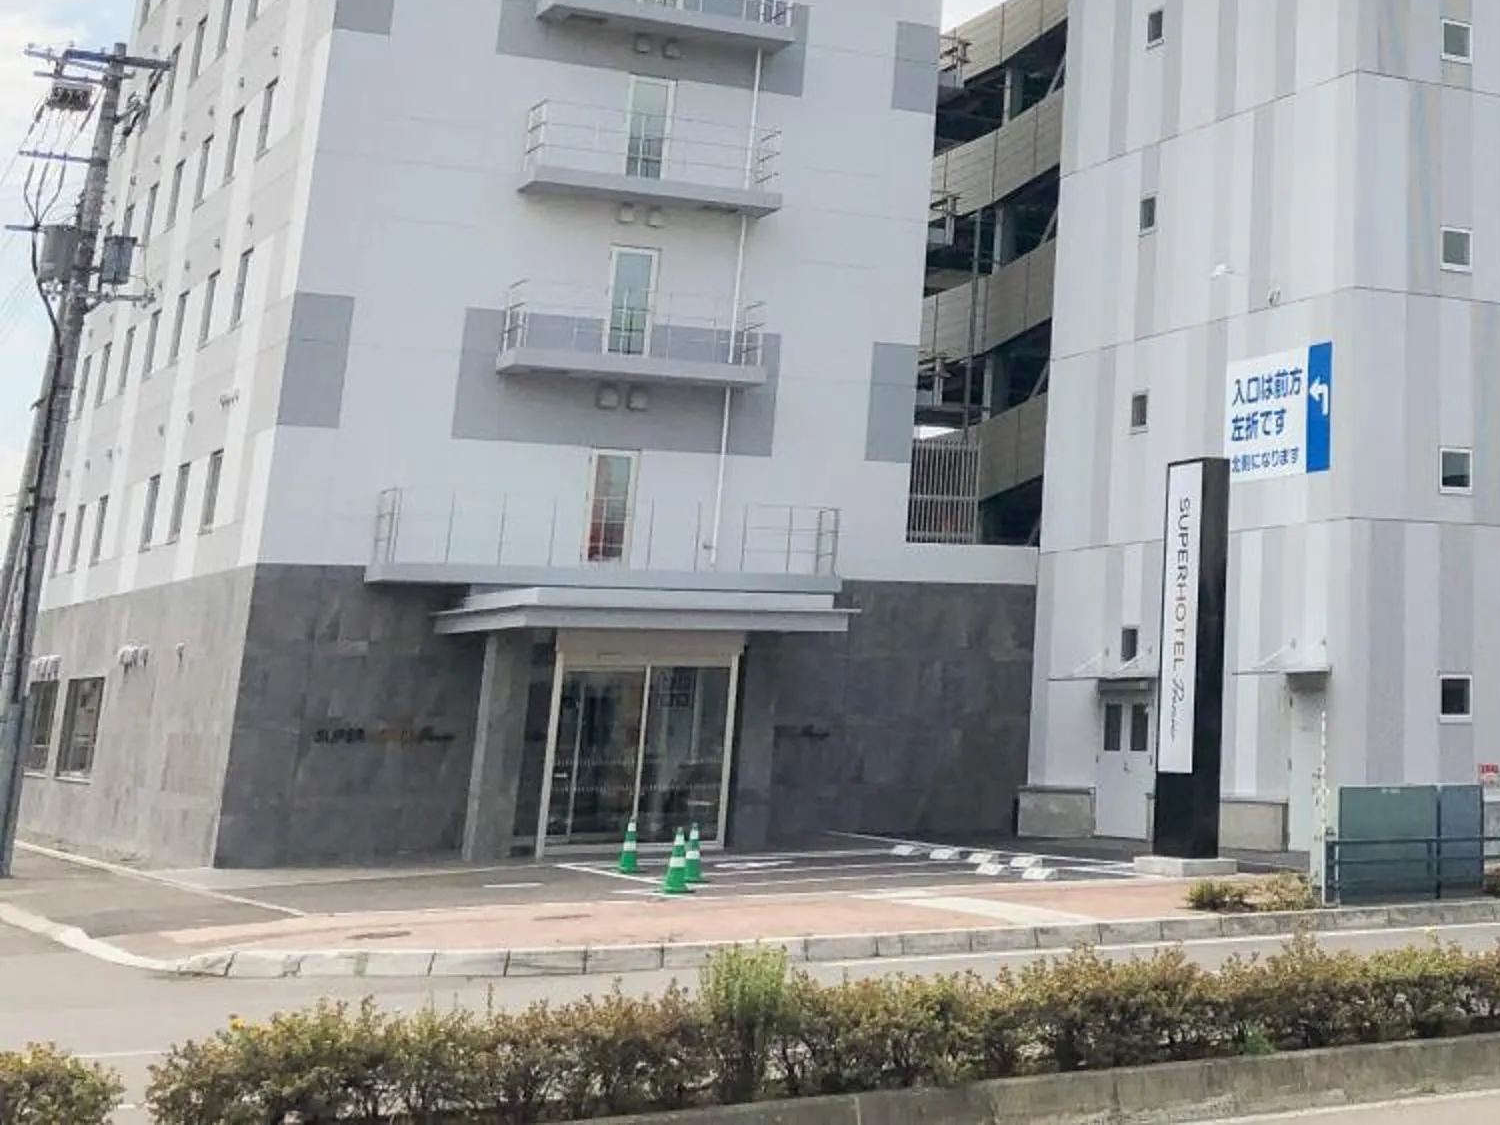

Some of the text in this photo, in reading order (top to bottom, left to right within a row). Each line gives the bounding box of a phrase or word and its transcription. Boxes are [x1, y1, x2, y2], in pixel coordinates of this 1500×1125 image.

[1231, 368, 1303, 406] 入口は前方
[1231, 409, 1287, 441] 左折です
[1173, 496, 1191, 672] SUPERHOTEL
